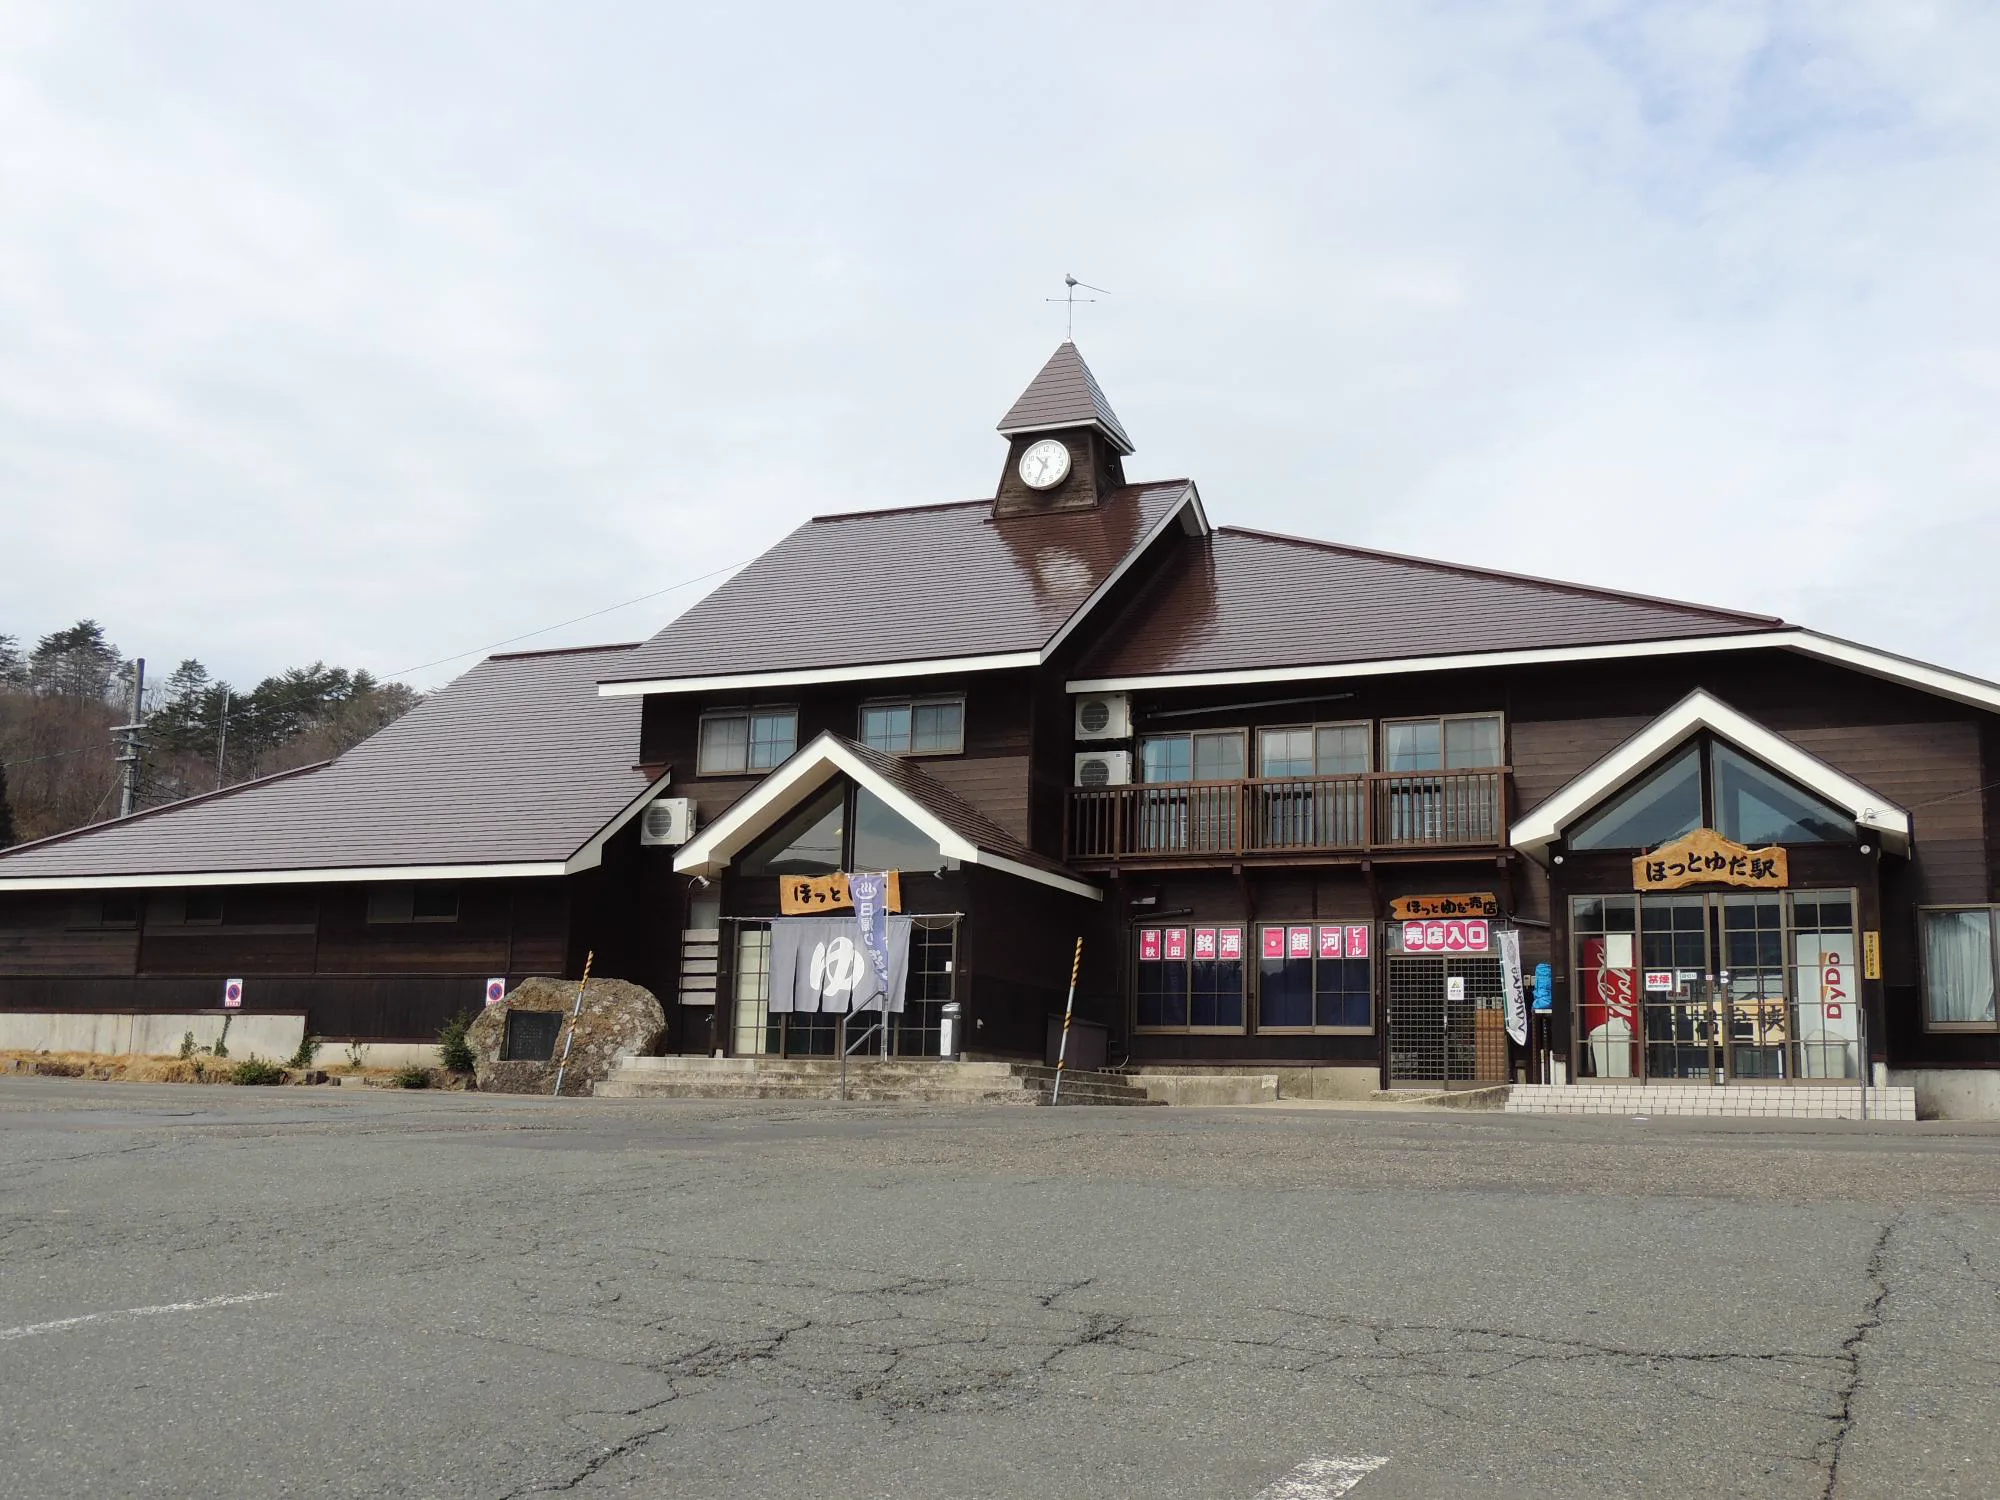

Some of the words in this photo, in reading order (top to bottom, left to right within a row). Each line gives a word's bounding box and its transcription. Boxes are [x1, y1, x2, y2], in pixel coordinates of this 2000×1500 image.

[1646, 851, 1778, 882] ほっとゆだ駅
[1405, 927, 1485, 945] 売店入口
[810, 937, 865, 996] ゆ
[1825, 952, 1846, 1019] DyDo
